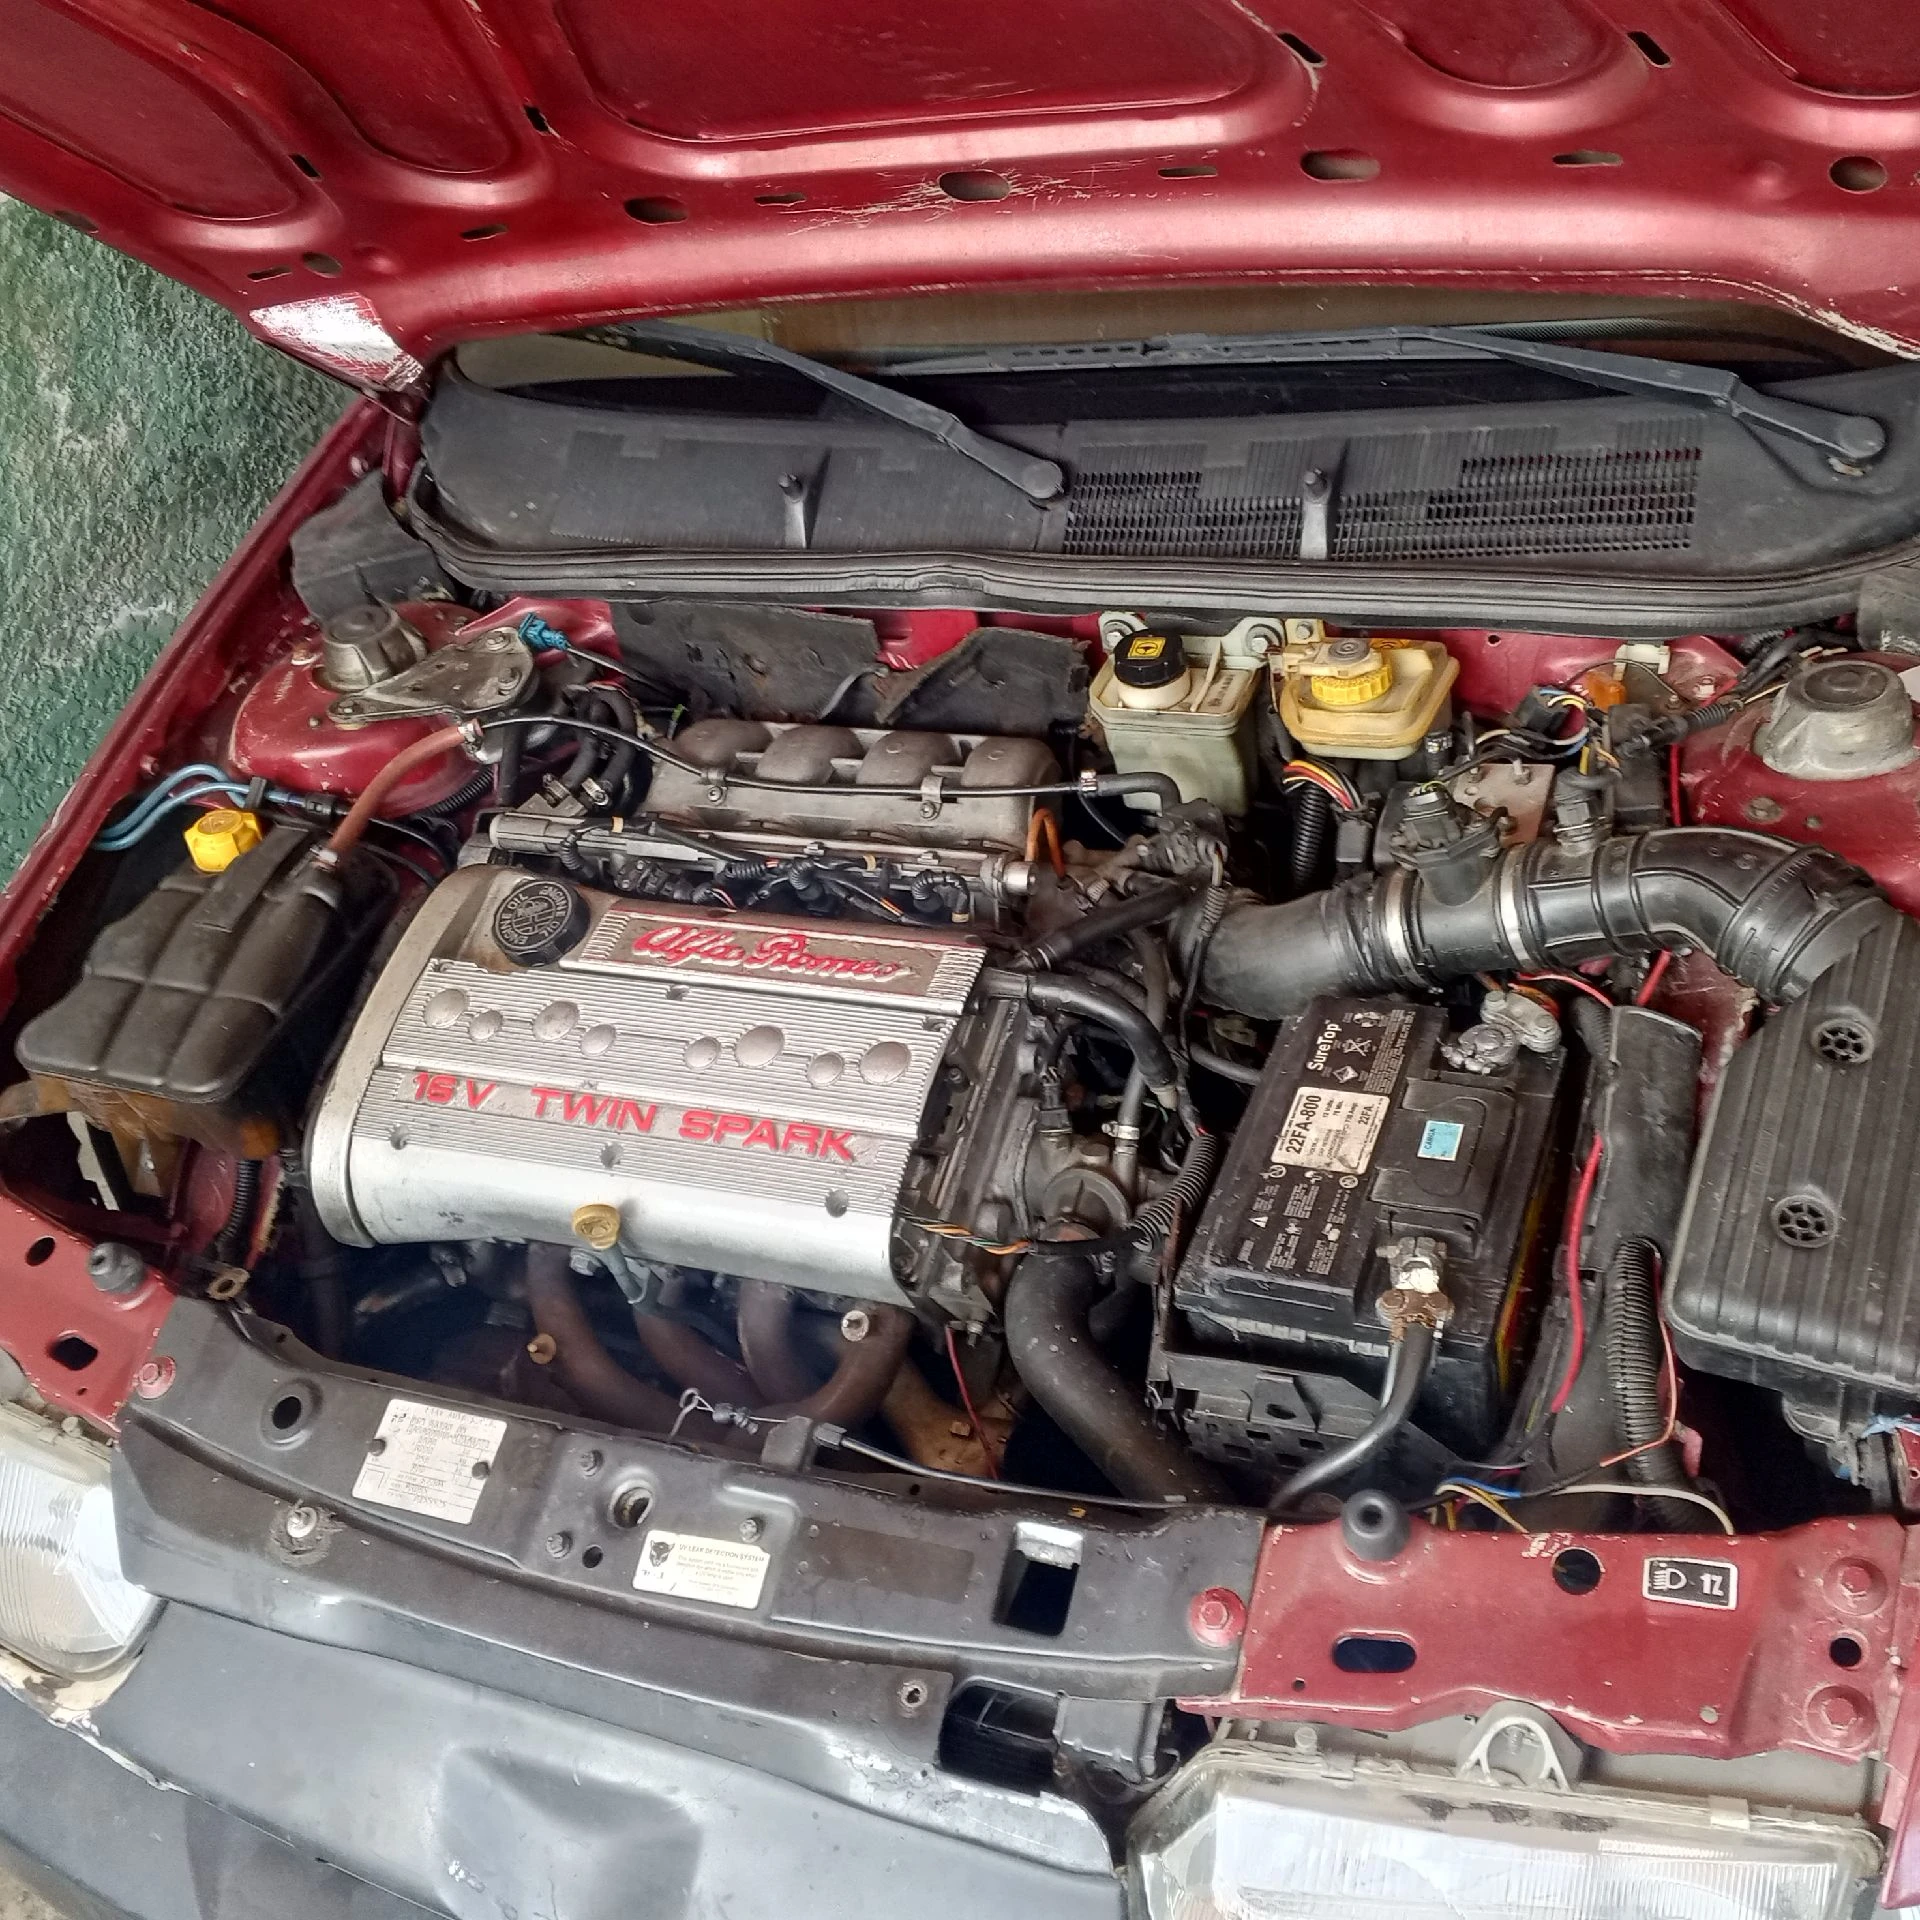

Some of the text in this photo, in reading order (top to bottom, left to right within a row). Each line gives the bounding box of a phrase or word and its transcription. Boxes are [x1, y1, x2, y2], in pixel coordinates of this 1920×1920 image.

[500, 893, 529, 945] ENGINE OIL
[539, 885, 568, 937] ENGINE OIL
[632, 924, 914, 983] Alfa Romeo
[1306, 1022, 1342, 1071] SureTop
[530, 1086, 658, 1134] TWIN
[678, 1109, 857, 1164] SPARK
[1285, 1095, 1322, 1155] 22FA-800
[688, 1545, 704, 1554] LEAK
[704, 1547, 739, 1560] DETECTION
[739, 1552, 765, 1562] SYSTEM
